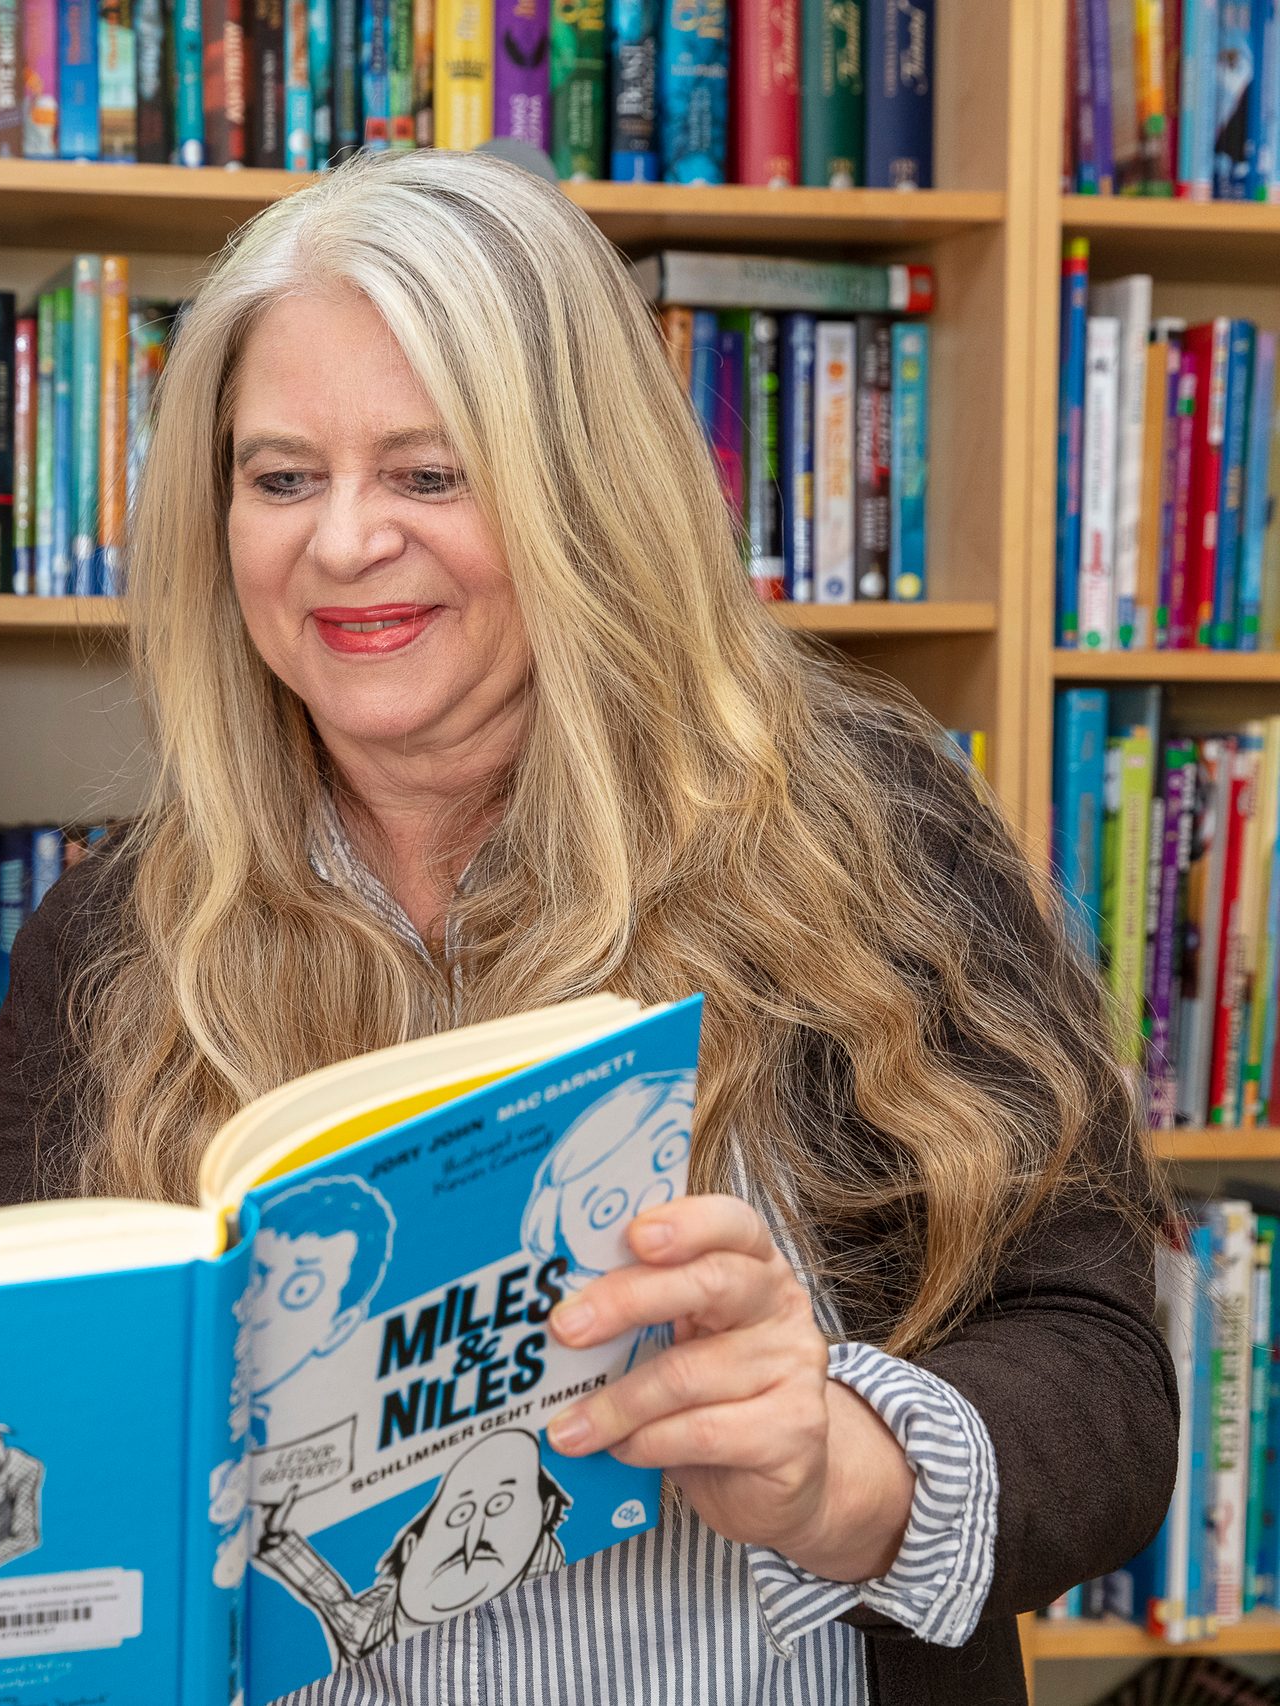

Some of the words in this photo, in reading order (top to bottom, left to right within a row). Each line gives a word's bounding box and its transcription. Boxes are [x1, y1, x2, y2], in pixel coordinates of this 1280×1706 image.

[428, 1116, 484, 1153] JOHN
[496, 1091, 542, 1123] MAC
[543, 1049, 636, 1102] BARNETT
[376, 1256, 570, 1381] MILES
[453, 1331, 503, 1377] &
[351, 1425, 474, 1494] SCHLIMMER
[480, 1400, 535, 1433] GEHT
[541, 1373, 608, 1410] IMMER
[377, 1331, 547, 1453] NILES
